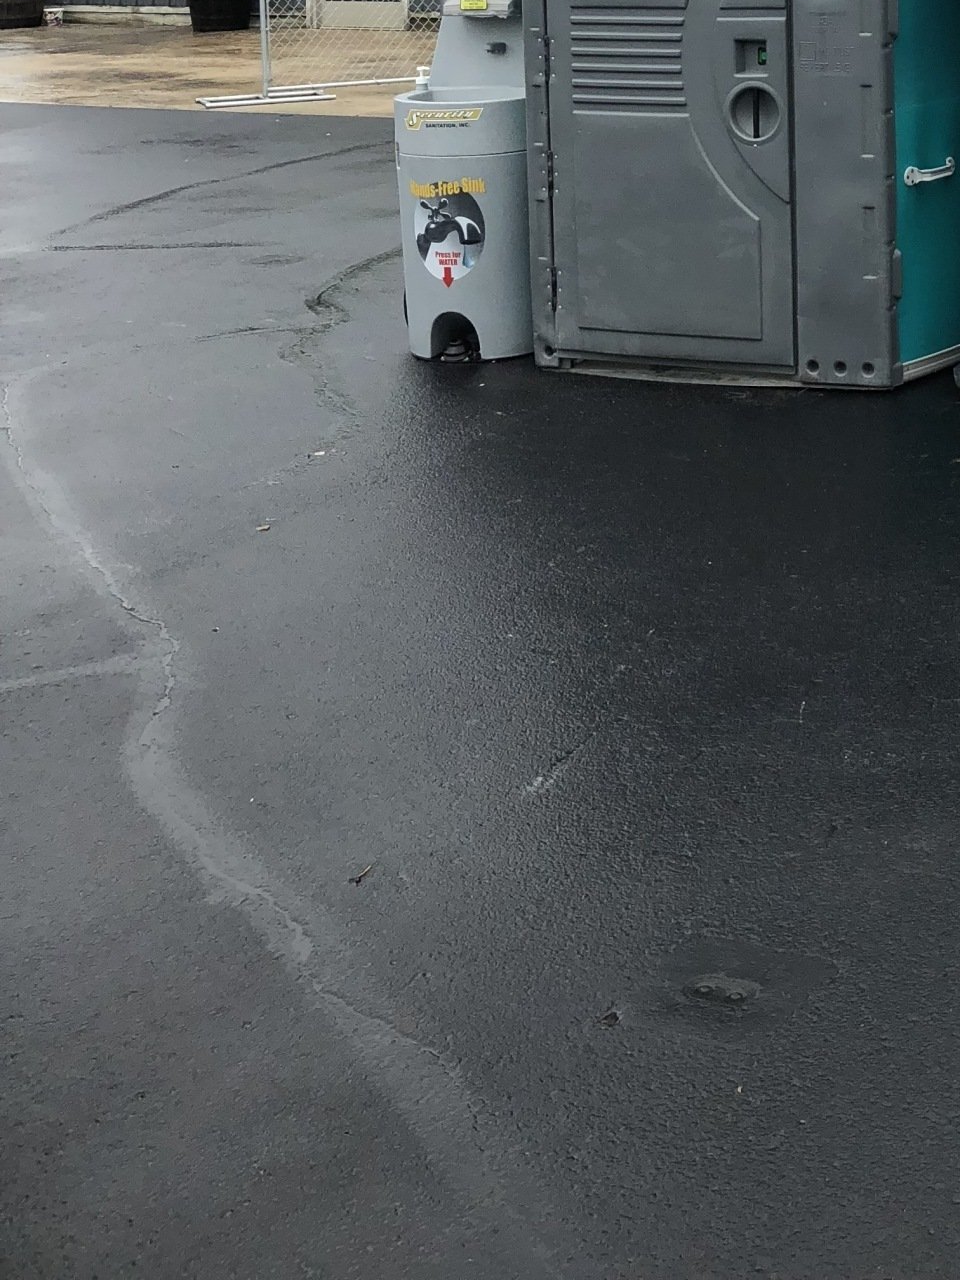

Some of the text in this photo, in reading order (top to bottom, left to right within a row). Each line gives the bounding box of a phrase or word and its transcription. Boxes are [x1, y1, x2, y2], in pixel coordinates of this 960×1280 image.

[408, 110, 474, 127] Security
[409, 176, 486, 198] Hands-Free Sink
